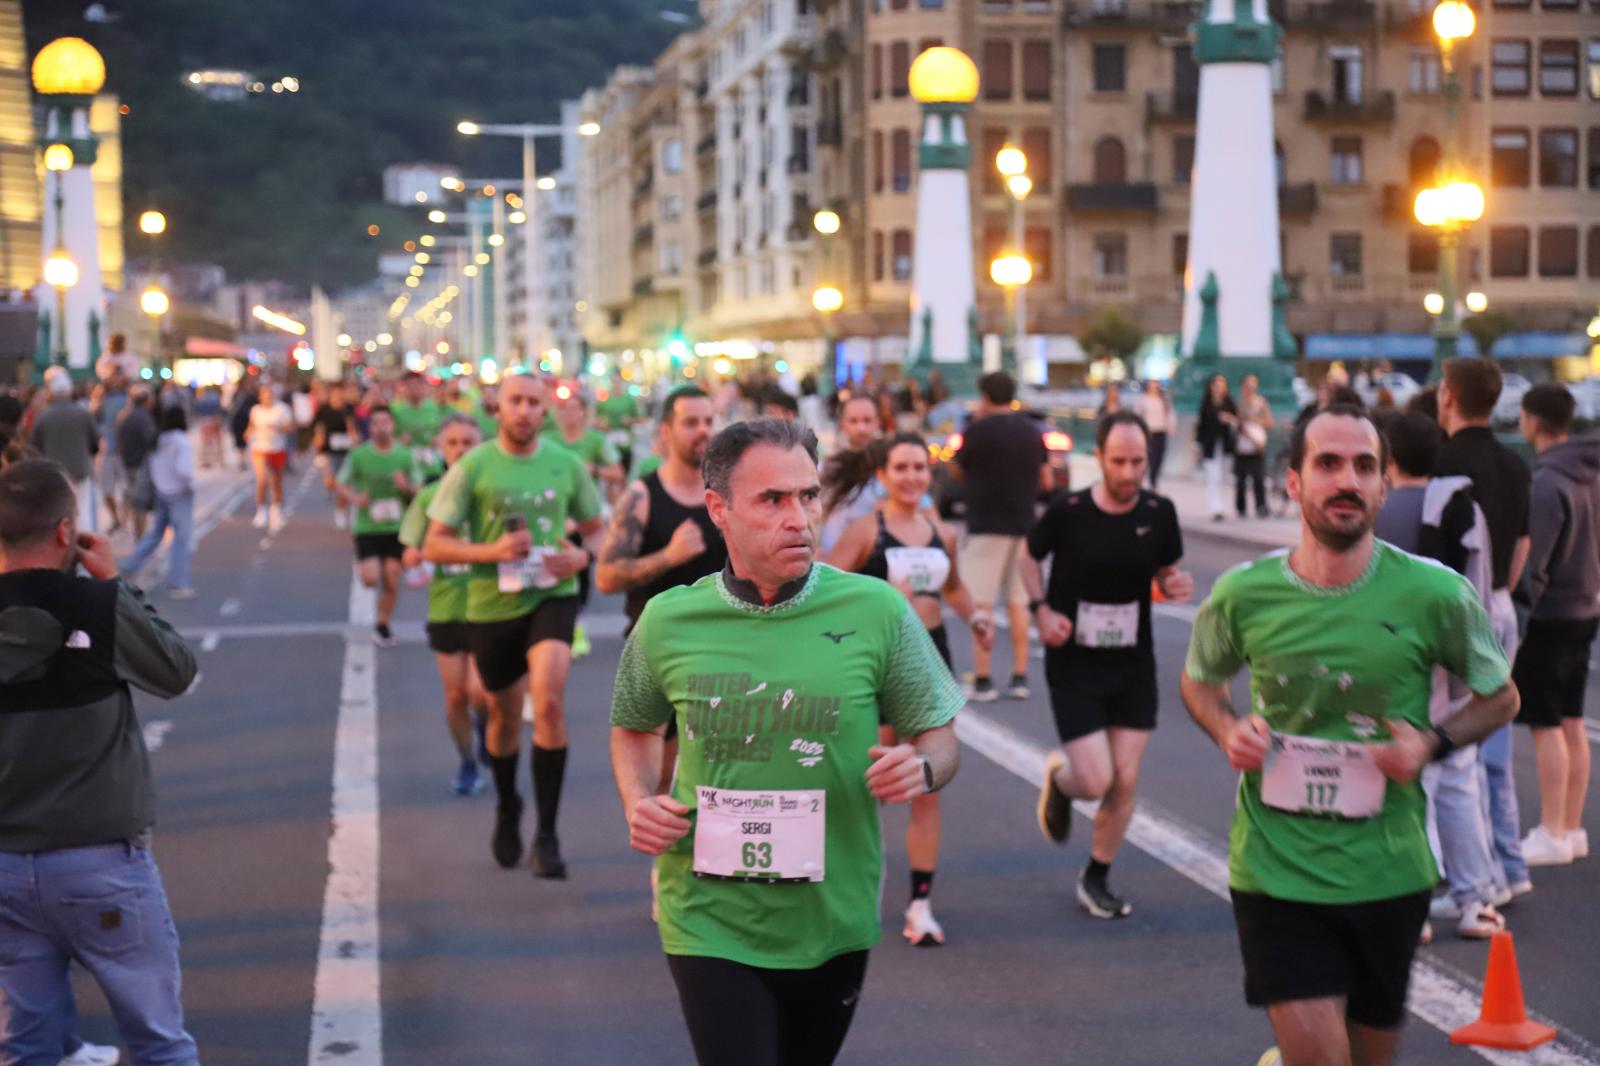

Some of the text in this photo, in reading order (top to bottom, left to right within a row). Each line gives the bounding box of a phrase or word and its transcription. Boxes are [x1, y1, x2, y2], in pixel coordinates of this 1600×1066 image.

[704, 738, 773, 762] SERIES
[789, 739, 824, 755] 2025
[1306, 782, 1338, 808] 117
[811, 798, 819, 813] 2
[741, 822, 772, 835] SERGI
[742, 841, 772, 868] 63
